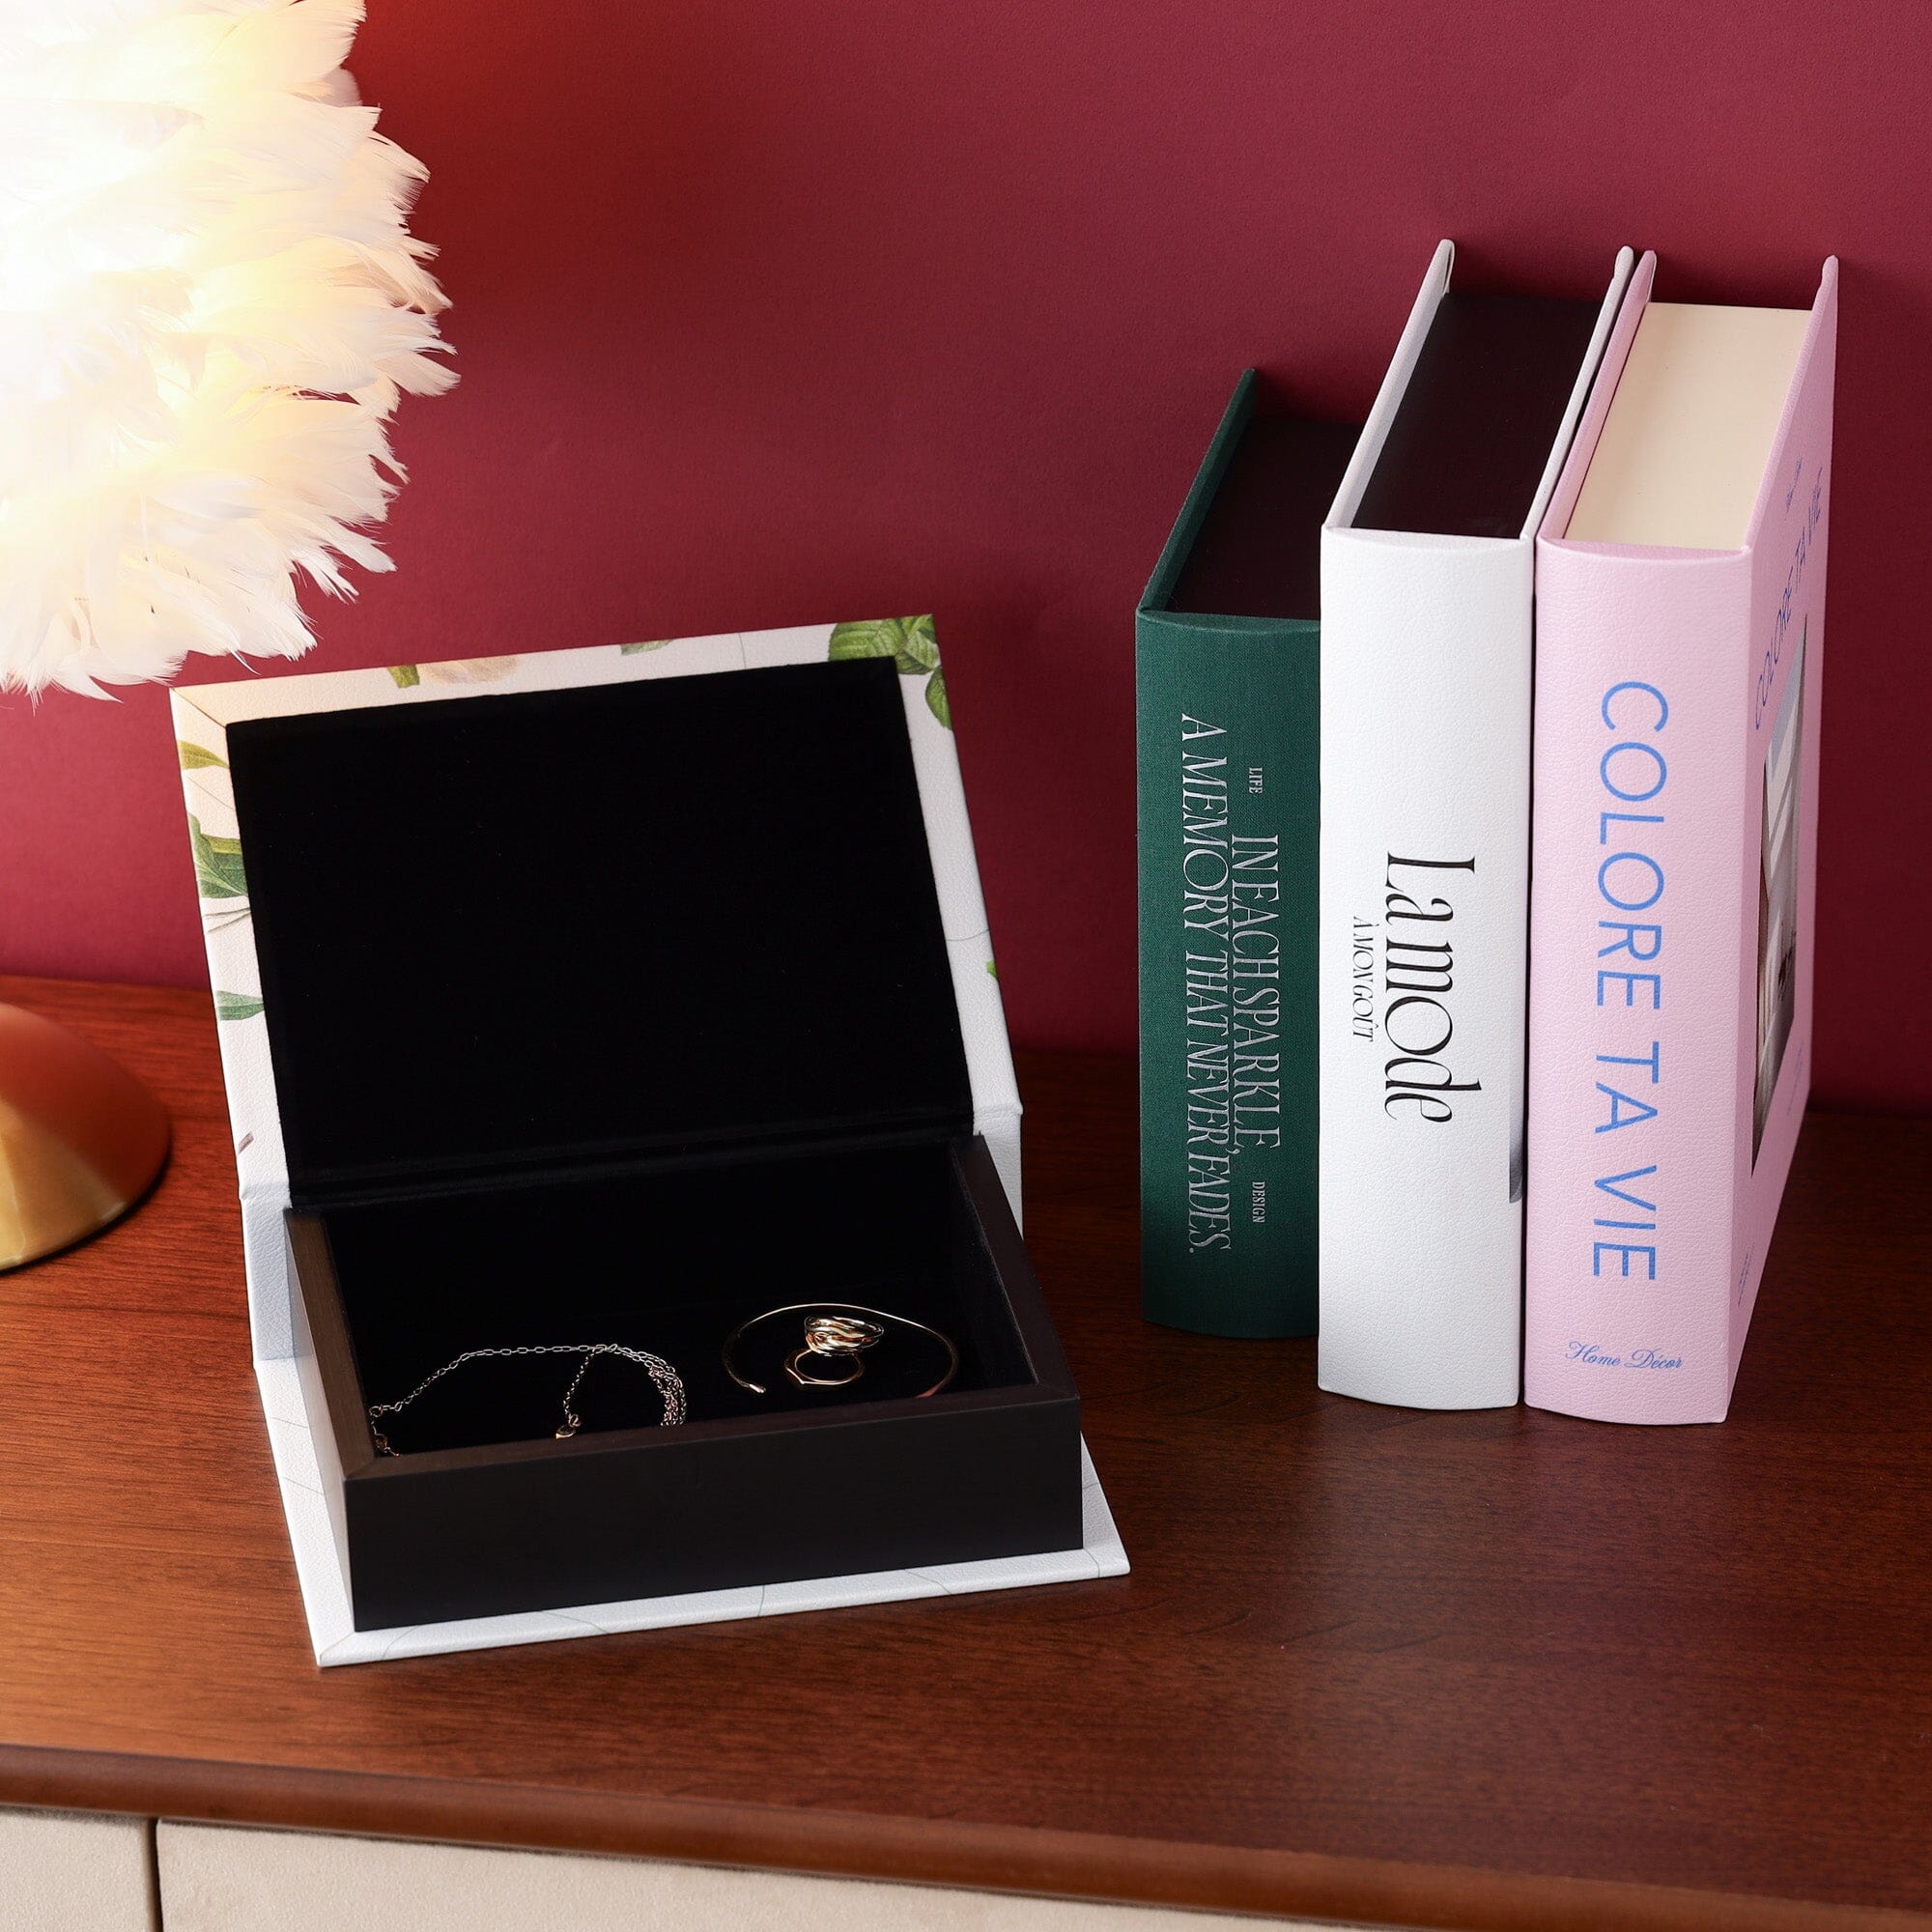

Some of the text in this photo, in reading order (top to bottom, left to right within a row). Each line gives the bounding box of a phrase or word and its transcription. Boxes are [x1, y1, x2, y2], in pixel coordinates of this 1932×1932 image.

[1754, 565, 1794, 731] COLORE
[1248, 767, 1264, 794] LIFE
[1181, 712, 1232, 1254] A MEMORY THAT NEVER FADES.
[1227, 834, 1281, 1156] IN EACH SPARKLE,
[1352, 915, 1379, 1042] À MON GOÛT
[1383, 850, 1483, 1123] La mode
[1593, 680, 1669, 1281] COLORE TA VIE
[1252, 1180, 1265, 1223] DESIGN
[1565, 1341, 1683, 1369] Home Décor
